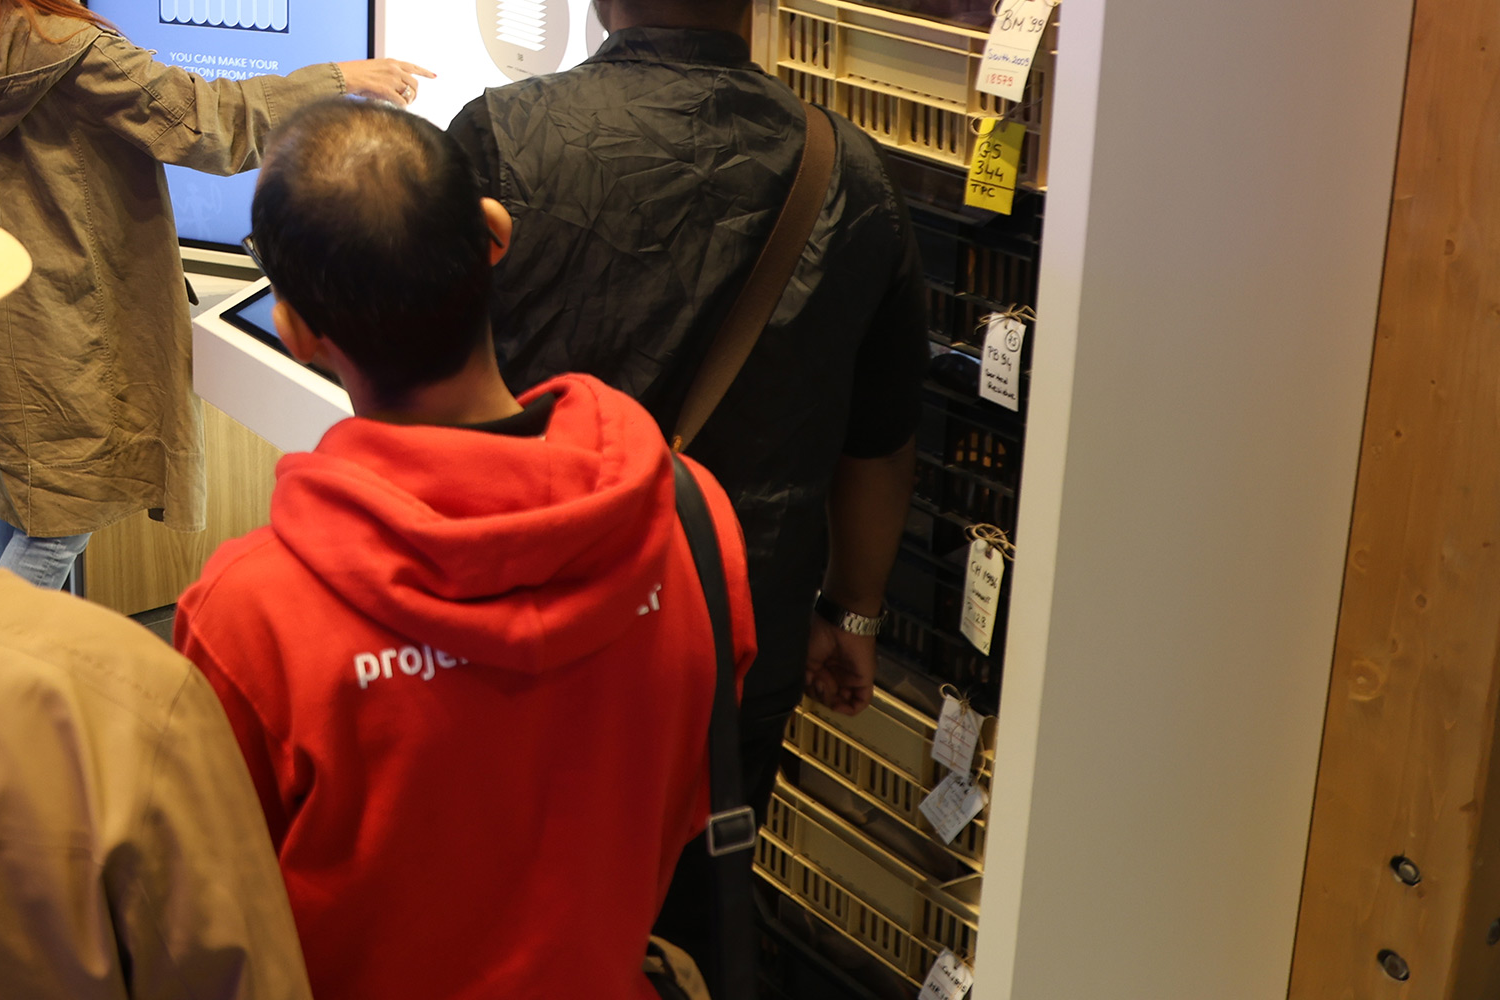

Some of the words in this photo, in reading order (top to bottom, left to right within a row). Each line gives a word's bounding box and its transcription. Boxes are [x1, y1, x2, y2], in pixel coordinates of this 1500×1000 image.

[169, 51, 193, 62] YOU
[194, 54, 217, 65] CAN
[218, 55, 248, 68] MAKE
[250, 59, 279, 71] YOUR
[216, 68, 247, 80] FROM
[975, 160, 1004, 182] 344
